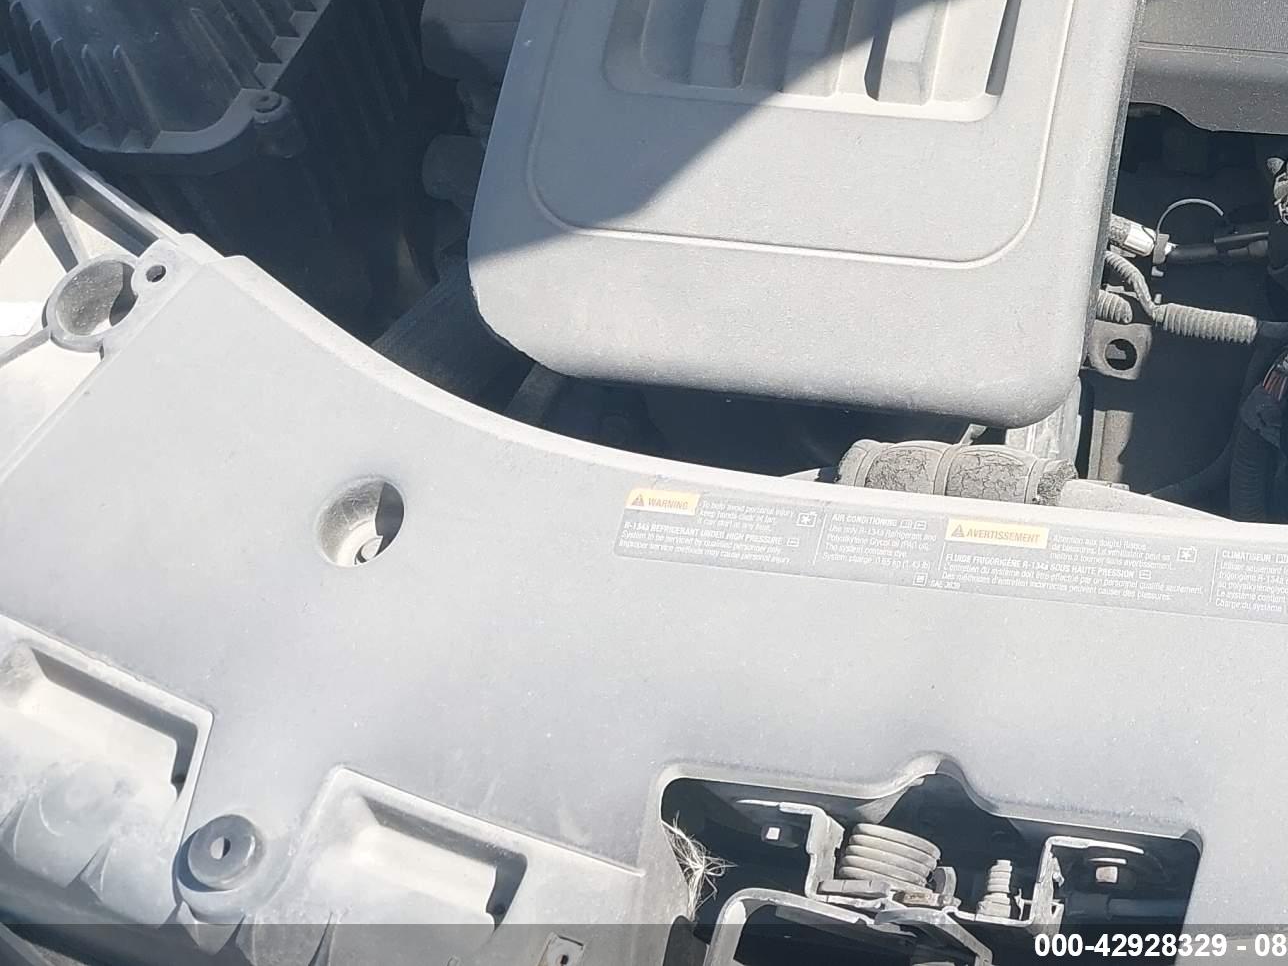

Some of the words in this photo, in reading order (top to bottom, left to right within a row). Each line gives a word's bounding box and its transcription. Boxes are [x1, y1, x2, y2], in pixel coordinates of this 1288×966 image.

[648, 497, 689, 510] WARNING
[832, 514, 845, 523] AIR
[650, 524, 700, 536] REFRIGERANT
[701, 529, 725, 539] UNDER
[726, 531, 744, 541] HIGH
[966, 528, 1041, 544] AVERTISSEMENT
[945, 554, 971, 563] FLUIDE
[1050, 563, 1071, 572] SOUS
[1072, 565, 1096, 575] HAUTE
[1097, 567, 1135, 579] PRESSION
